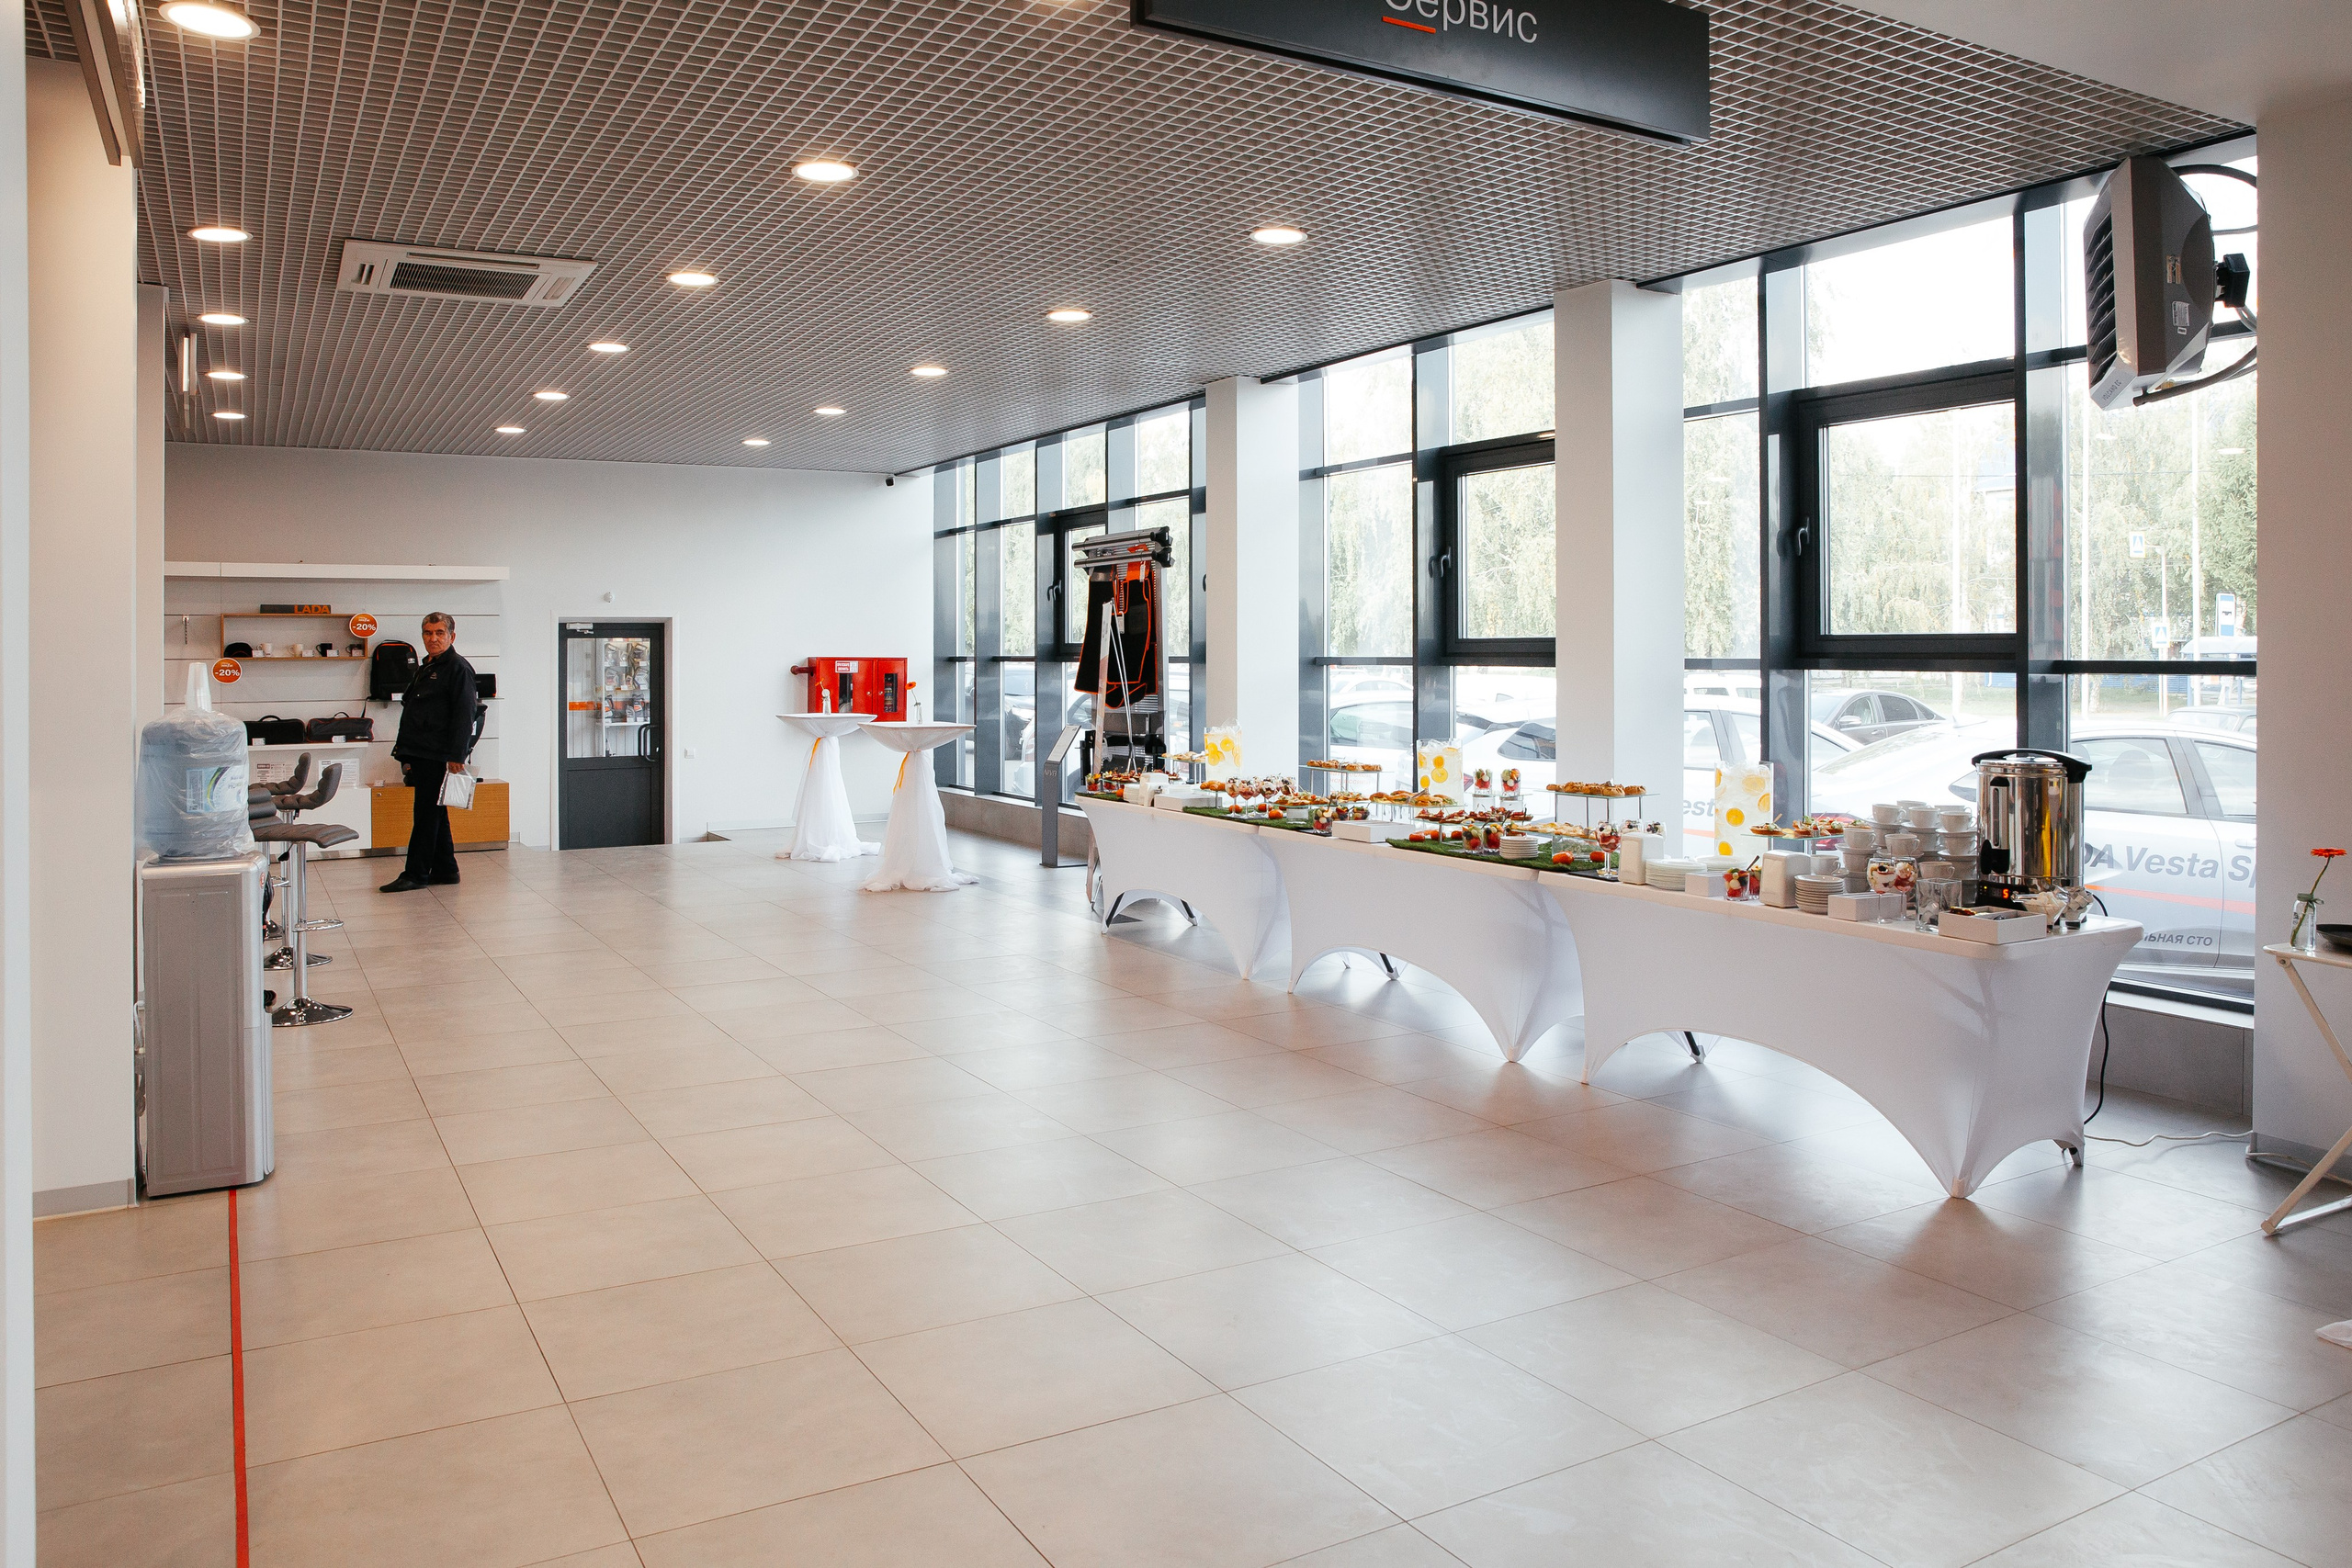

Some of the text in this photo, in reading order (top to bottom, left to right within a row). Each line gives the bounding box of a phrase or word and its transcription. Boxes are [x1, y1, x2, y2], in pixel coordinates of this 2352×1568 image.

[1385, 0, 1537, 43] ервис
[294, 604, 331, 614] LADA
[352, 623, 377, 631] -20%
[214, 669, 241, 677] -20%
[1683, 798, 1715, 817] est
[2126, 845, 2219, 879] Vesta
[2187, 935, 2213, 946] СТО
